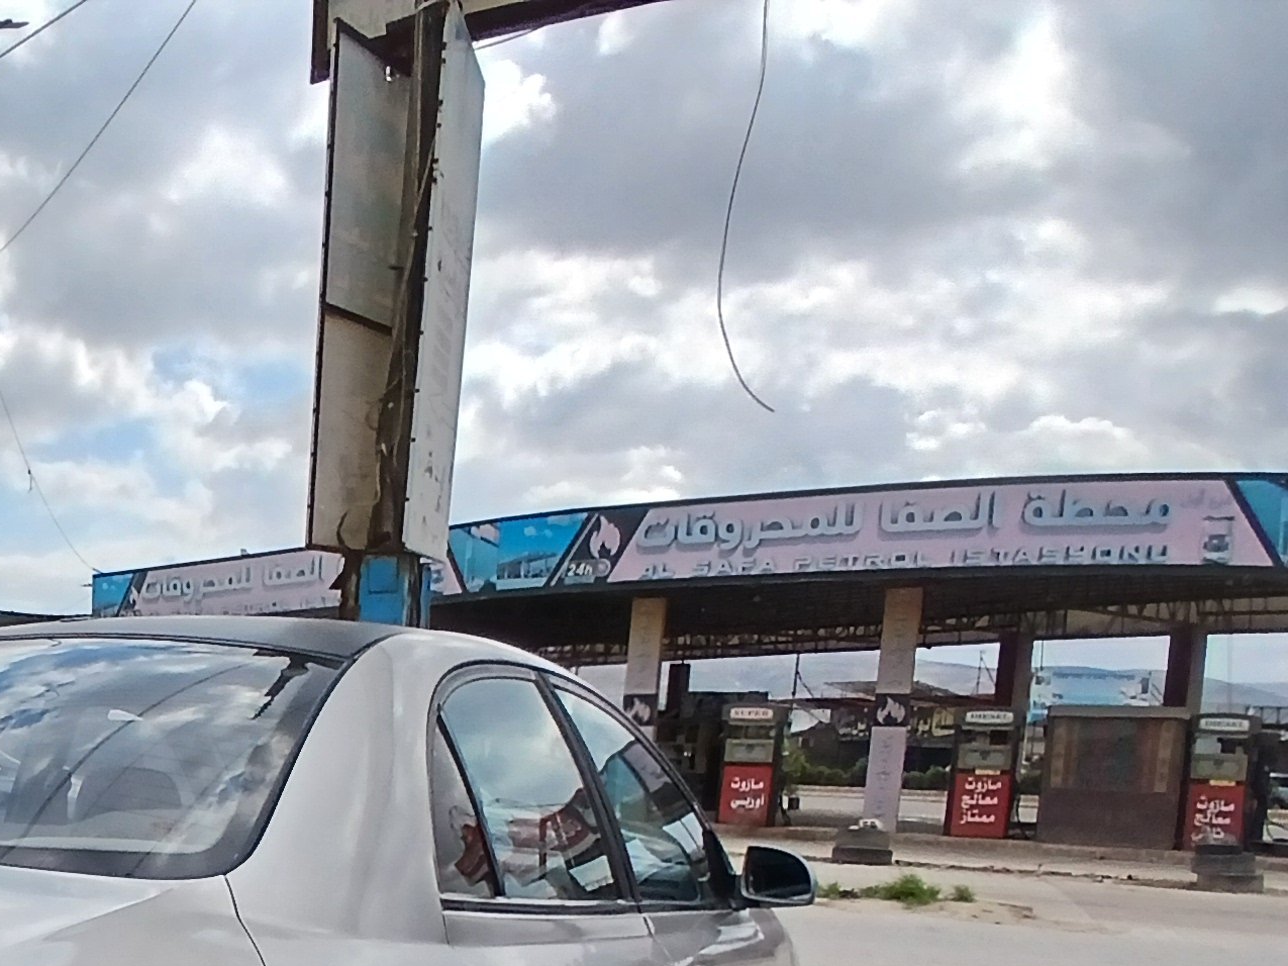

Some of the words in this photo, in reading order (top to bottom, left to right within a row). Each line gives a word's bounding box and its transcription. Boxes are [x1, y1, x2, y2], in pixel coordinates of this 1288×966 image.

[878, 489, 997, 534] الصفا
[1021, 488, 1172, 528] محطة
[637, 501, 862, 552] للمحروقات
[692, 559, 776, 578] SAFA
[793, 550, 930, 573] PETROL
[730, 776, 765, 792] مازوت
[964, 777, 1002, 792] مازوت
[1196, 795, 1235, 813] مازوت
